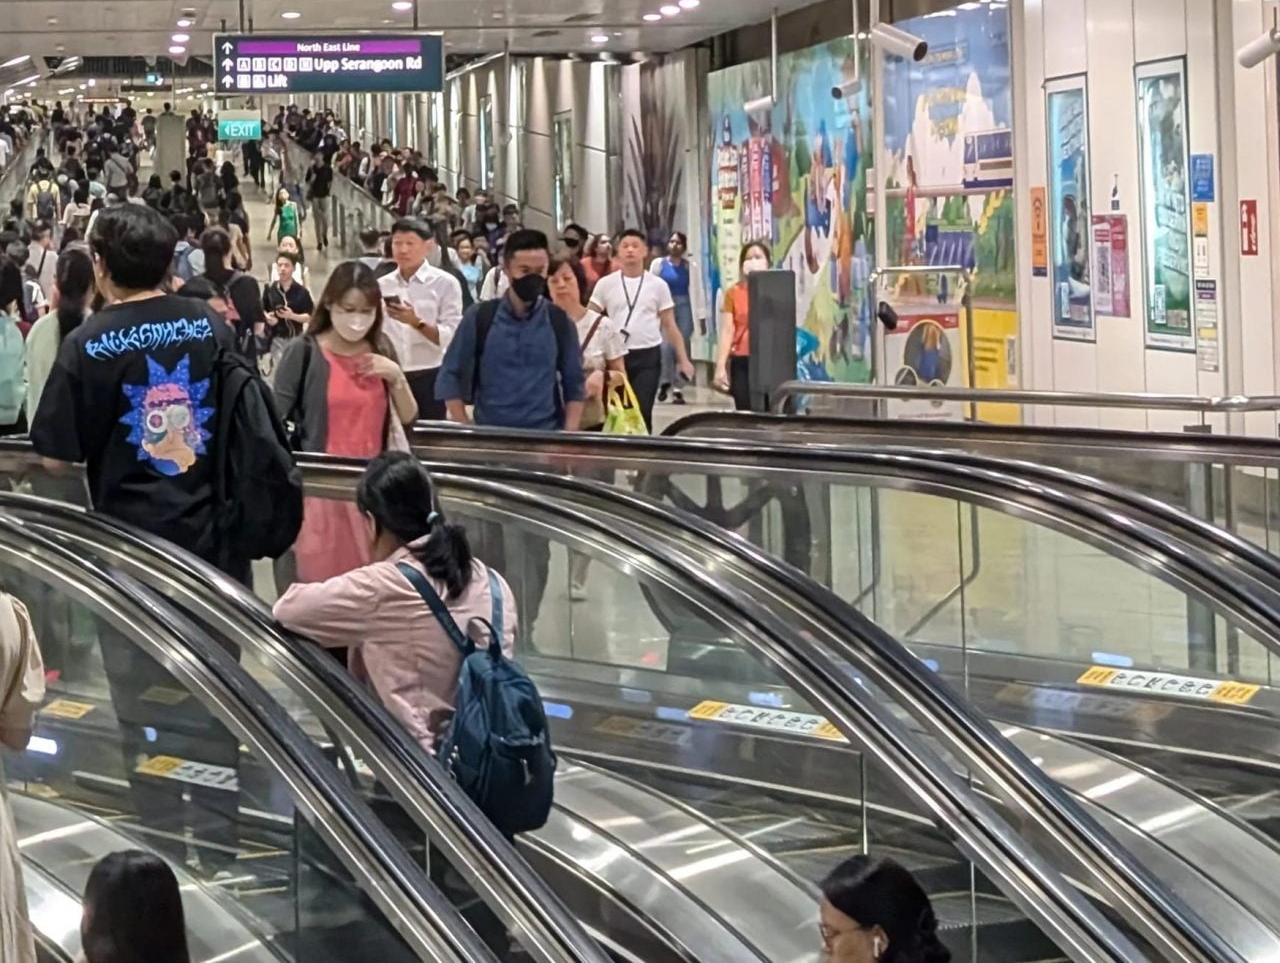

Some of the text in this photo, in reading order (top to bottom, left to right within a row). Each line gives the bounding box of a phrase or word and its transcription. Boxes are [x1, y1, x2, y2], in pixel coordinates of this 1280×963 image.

[296, 42, 361, 52] North East Line
[314, 57, 339, 73] Upp
[341, 57, 404, 73] Serangoon
[405, 55, 423, 70] Rd
[230, 123, 255, 136] EXIT
